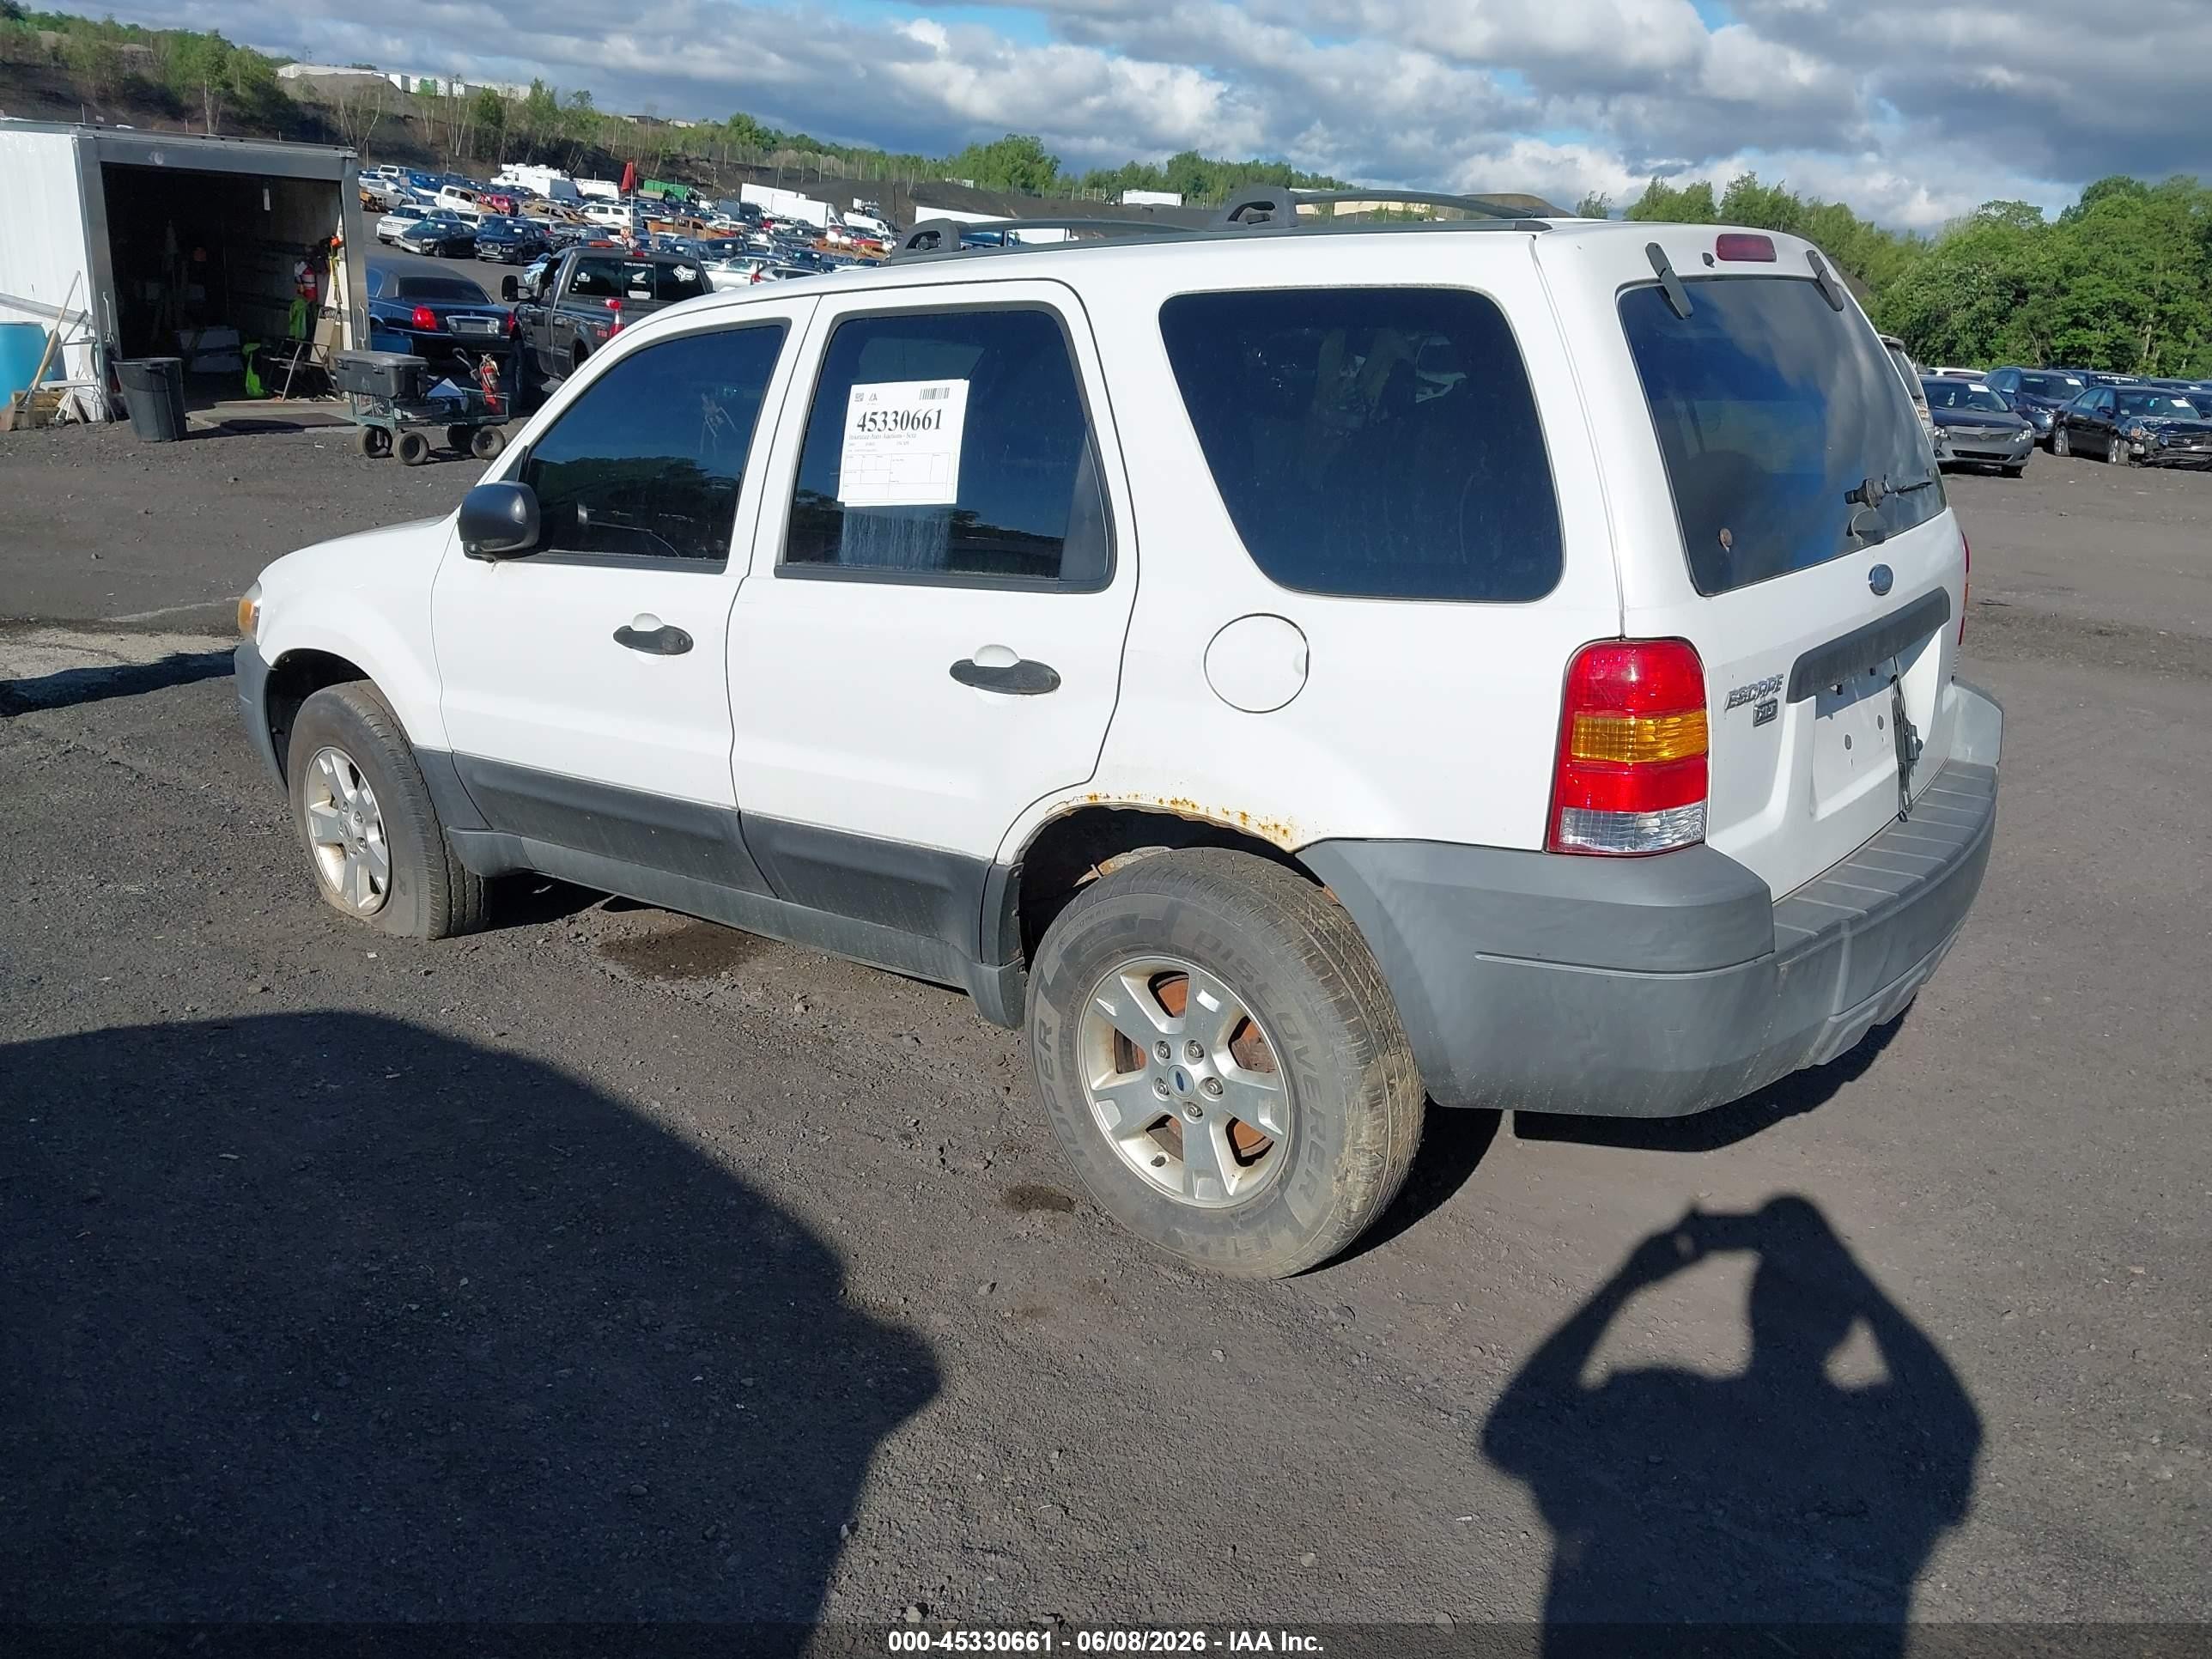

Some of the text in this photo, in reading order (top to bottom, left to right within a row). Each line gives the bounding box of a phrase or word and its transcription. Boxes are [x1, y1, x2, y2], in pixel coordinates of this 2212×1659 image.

[856, 409, 942, 432] 45330661
[1724, 673, 1784, 712] ESCAPE
[1036, 1021, 1085, 1161] OPER
[1194, 930, 1329, 1202] DISCOVERER
